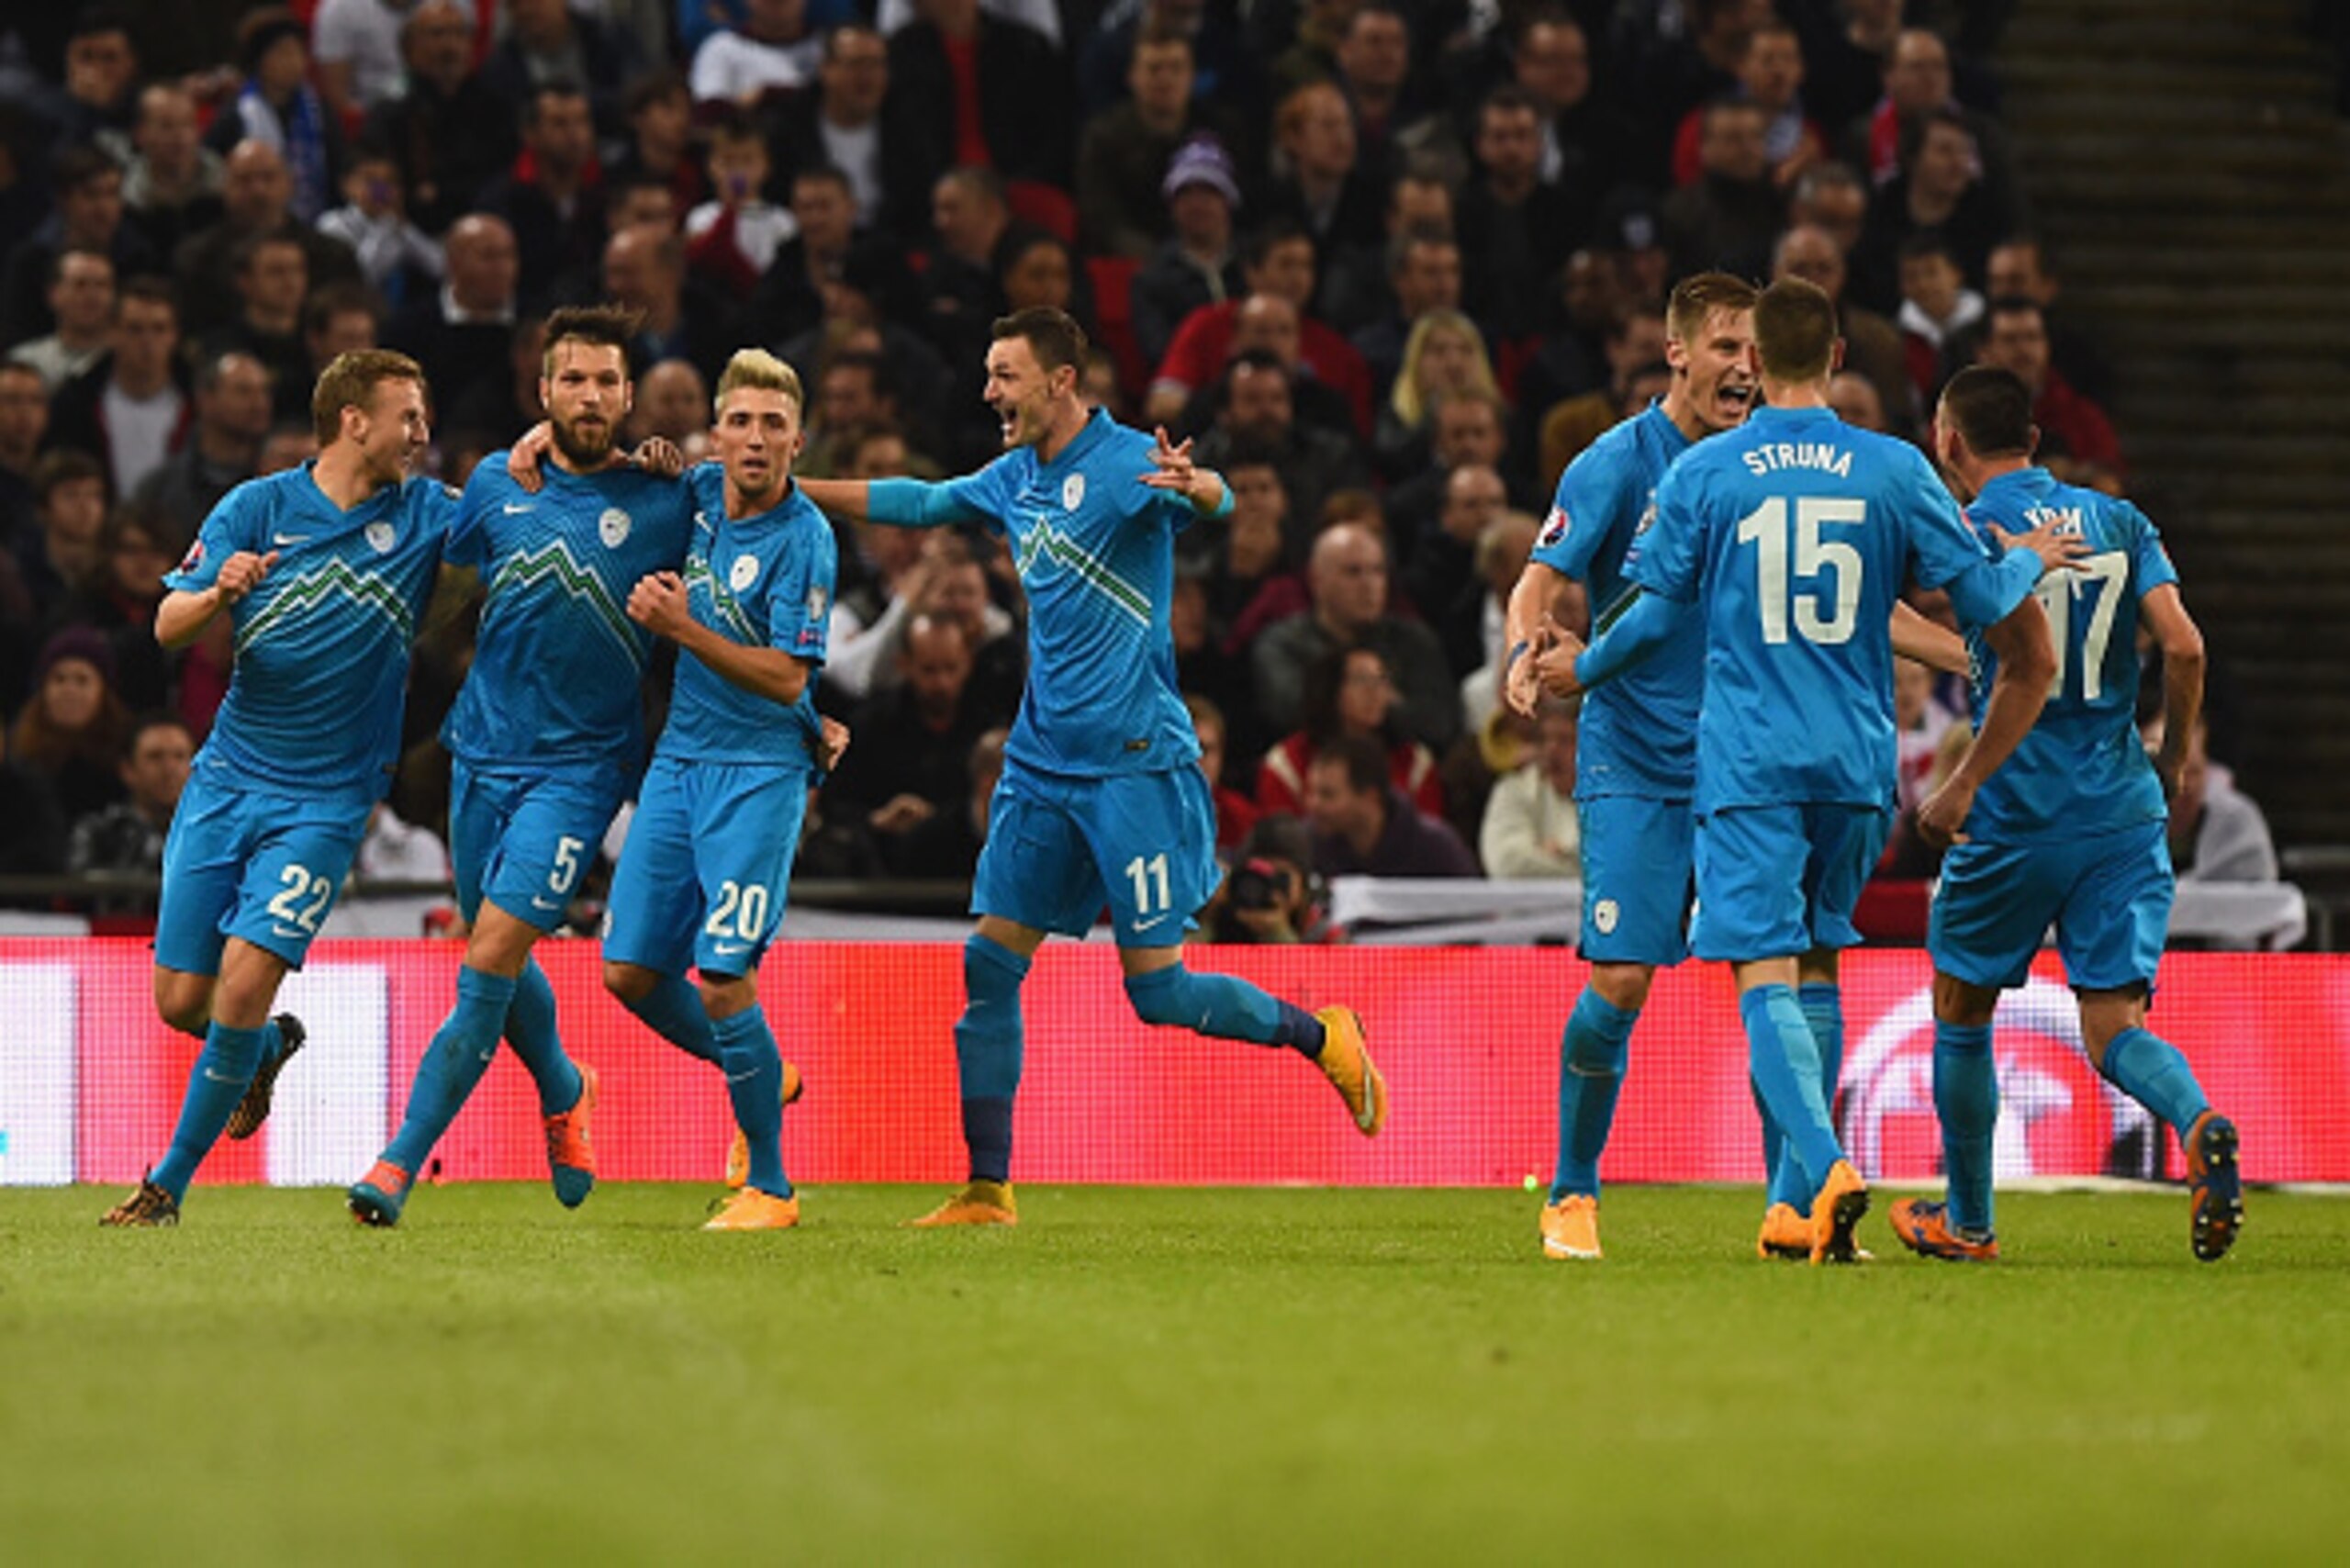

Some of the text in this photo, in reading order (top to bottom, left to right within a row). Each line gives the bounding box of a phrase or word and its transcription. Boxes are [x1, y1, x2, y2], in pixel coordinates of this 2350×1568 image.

[1743, 443, 1852, 478] STRUNA
[1738, 496, 1866, 644] 15
[2033, 551, 2129, 700] 17
[550, 836, 584, 894] 5
[1125, 853, 1171, 913] 11
[267, 864, 330, 933] 22
[706, 880, 767, 942] 20
